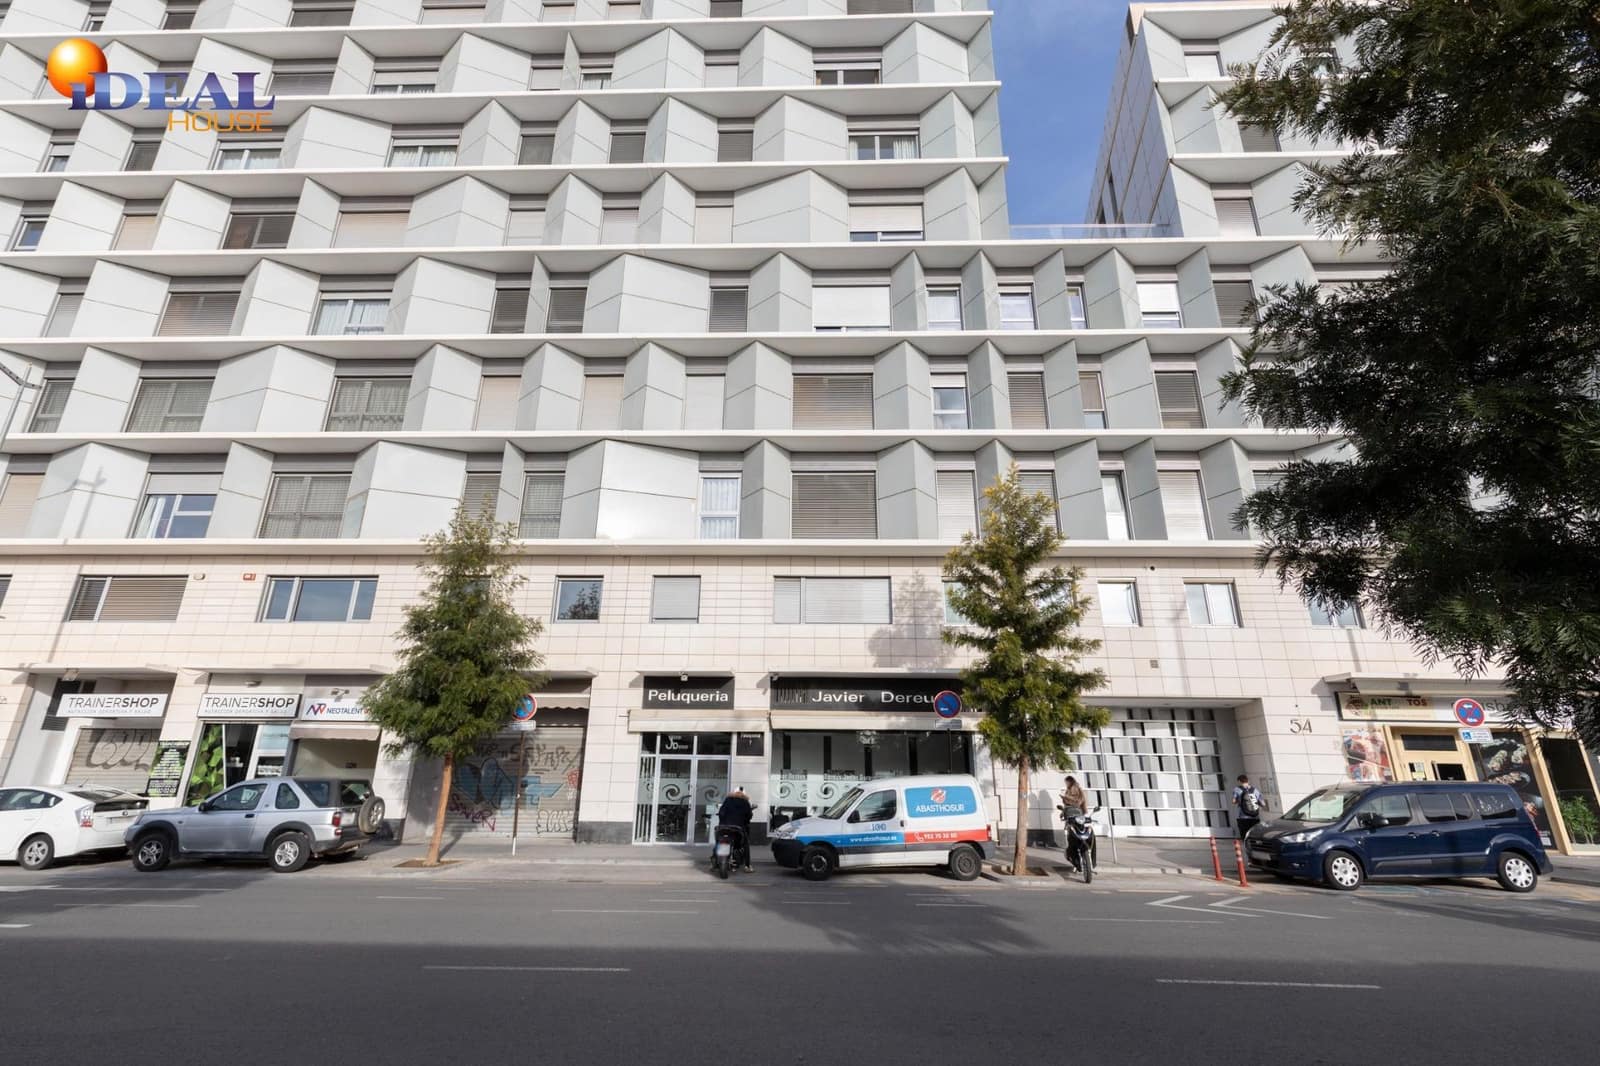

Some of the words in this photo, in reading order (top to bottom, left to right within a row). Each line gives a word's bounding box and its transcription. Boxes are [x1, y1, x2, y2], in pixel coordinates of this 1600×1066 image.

[648, 689, 729, 704] Peluqueria
[811, 691, 865, 703] Javier
[881, 691, 937, 703] Dereu
[69, 697, 159, 708] TRAINERSHOP
[205, 697, 295, 708] TRAINERSHOP
[1289, 719, 1313, 734] 54
[915, 804, 965, 813] ABASTHOSUR
